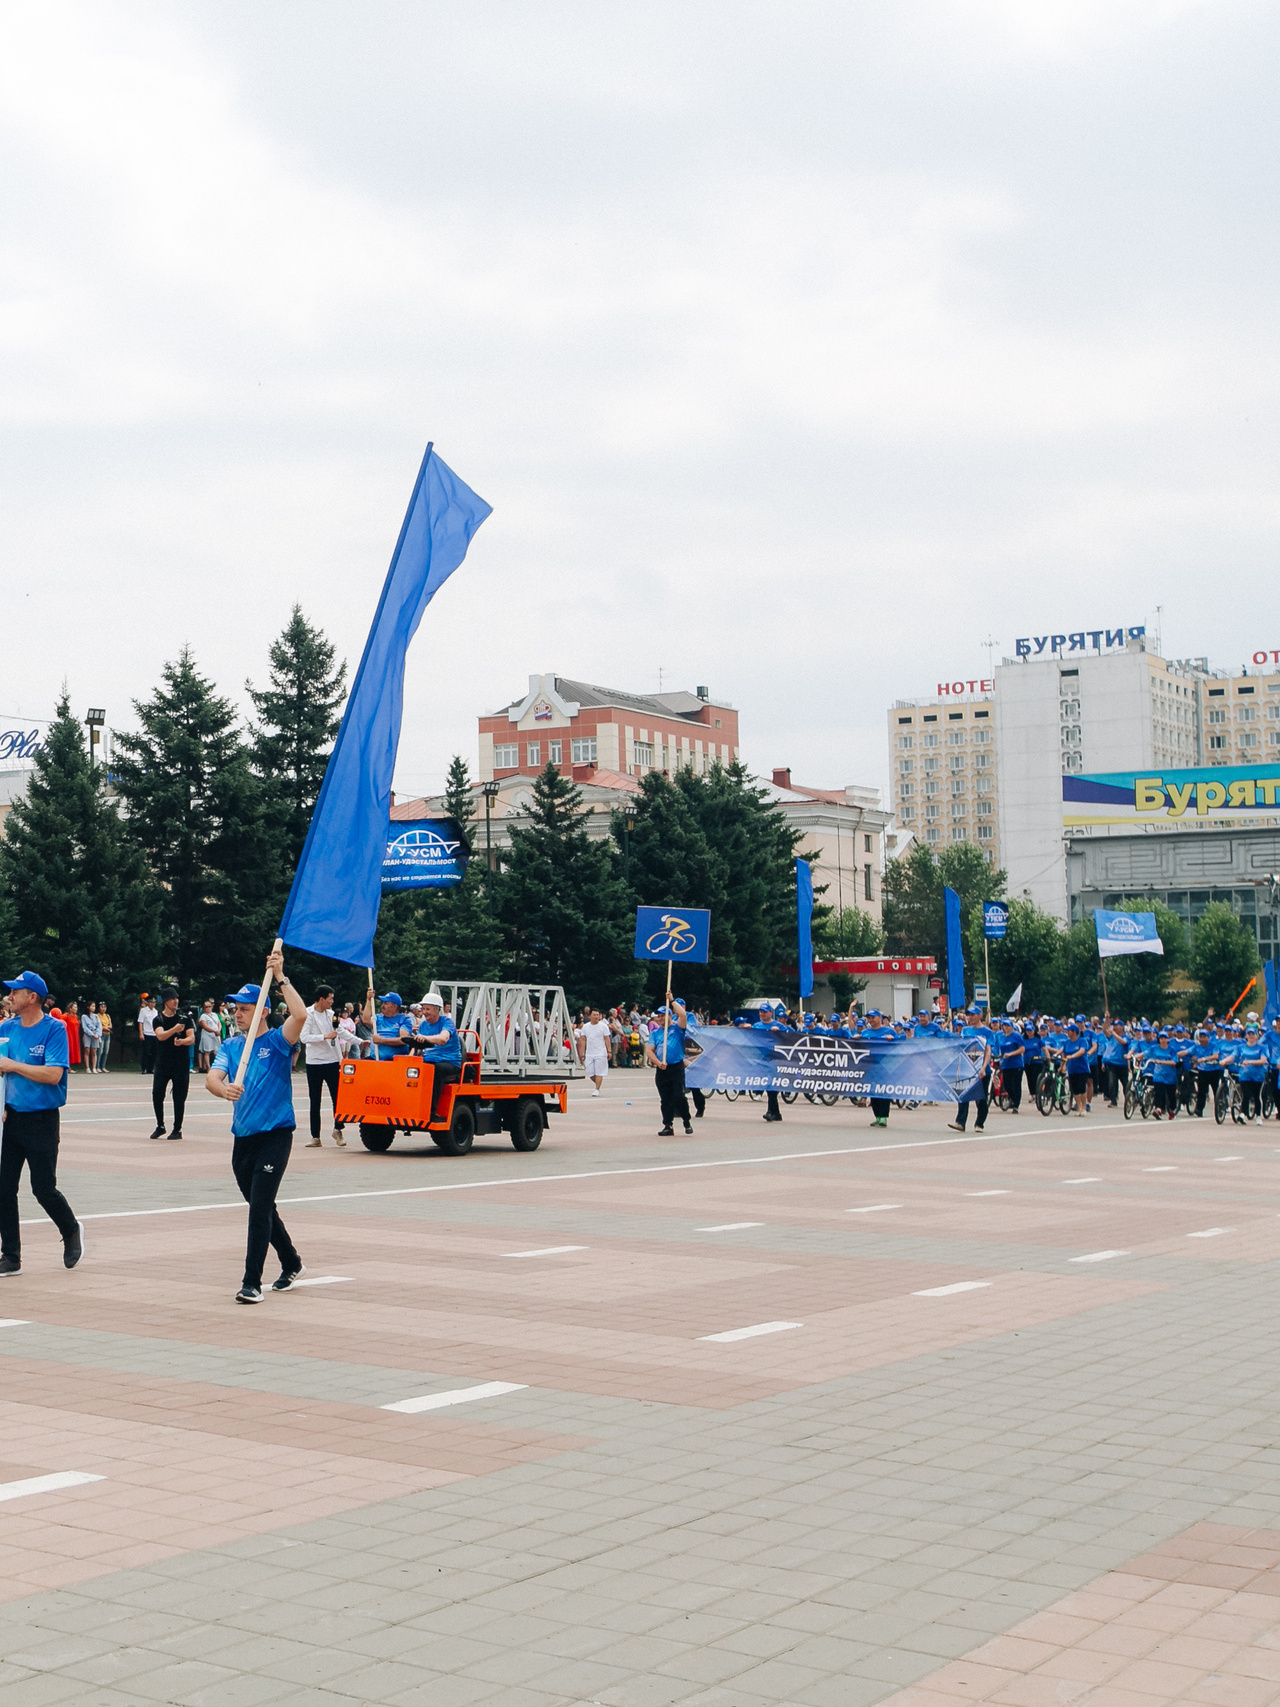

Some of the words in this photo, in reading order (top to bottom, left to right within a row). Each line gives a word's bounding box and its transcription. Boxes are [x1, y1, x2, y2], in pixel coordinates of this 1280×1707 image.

[1015, 626, 1145, 656] БУРЯТИЯ
[937, 679, 996, 696] HOTE
[1135, 776, 1280, 817] Бурят
[397, 846, 442, 857] У-УСМ
[797, 1051, 849, 1068] У-УСМ
[776, 1065, 865, 1079] УЛАН-УДЭСТАЛЬМОСТ
[716, 1072, 741, 1085] Без
[744, 1076, 769, 1087] нас
[772, 1077, 790, 1088] не
[793, 1078, 871, 1093] строятся
[875, 1083, 928, 1096] мосты
